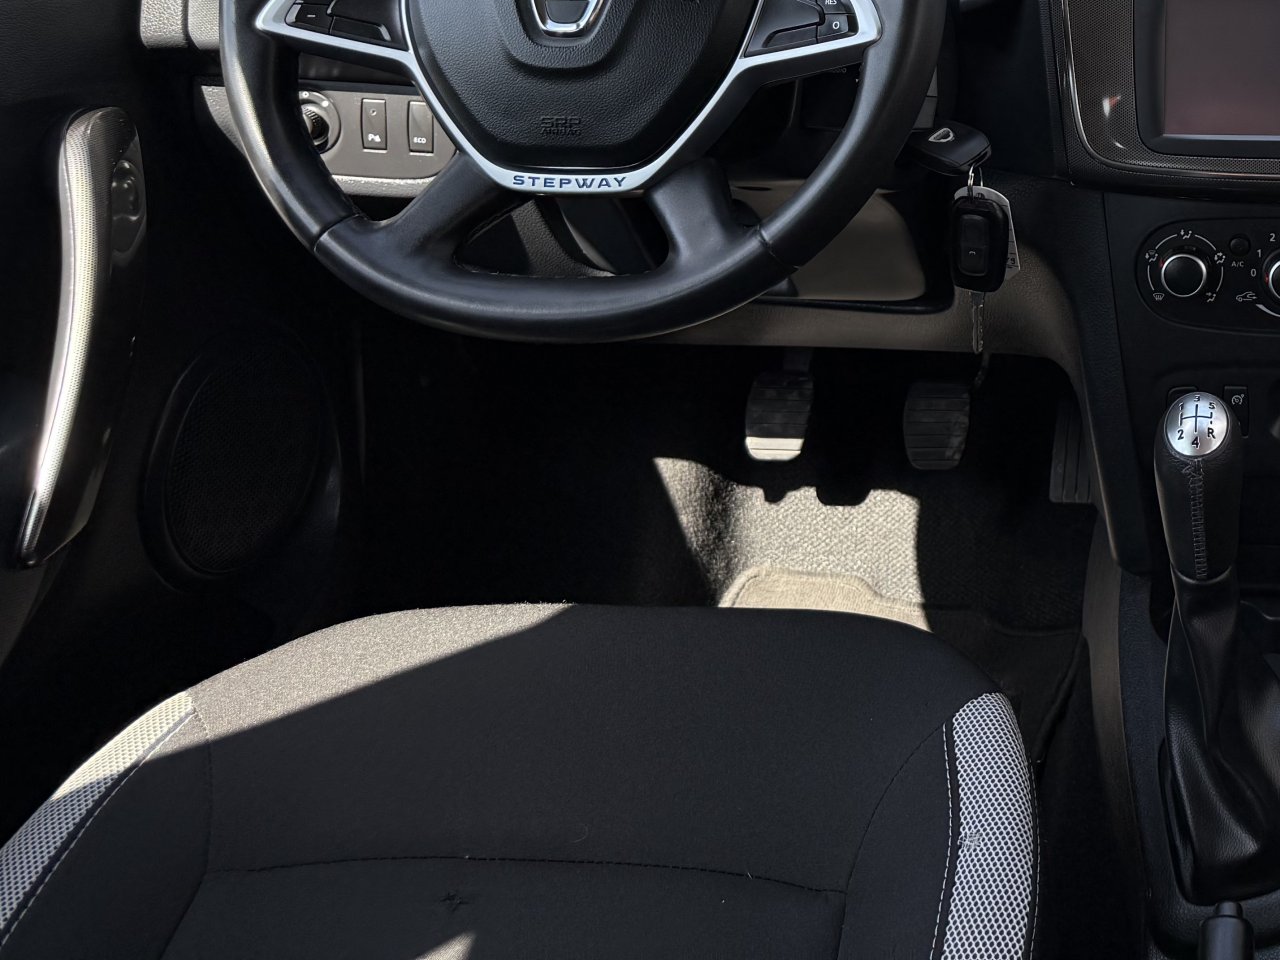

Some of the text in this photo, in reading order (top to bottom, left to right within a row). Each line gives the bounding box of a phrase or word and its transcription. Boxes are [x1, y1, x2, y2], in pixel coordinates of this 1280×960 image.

[541, 116, 582, 128] SRP
[513, 175, 627, 189] STEPWAY
[1269, 233, 1276, 242] 2
[1257, 249, 1262, 258] 1
[1231, 260, 1245, 268] A/C
[1250, 269, 1257, 277] 0
[1194, 394, 1201, 402] 3
[1179, 402, 1184, 411] 1
[1208, 401, 1216, 410] 5
[1177, 428, 1184, 440] 2
[1207, 427, 1216, 439] R
[1191, 436, 1200, 449] 4
